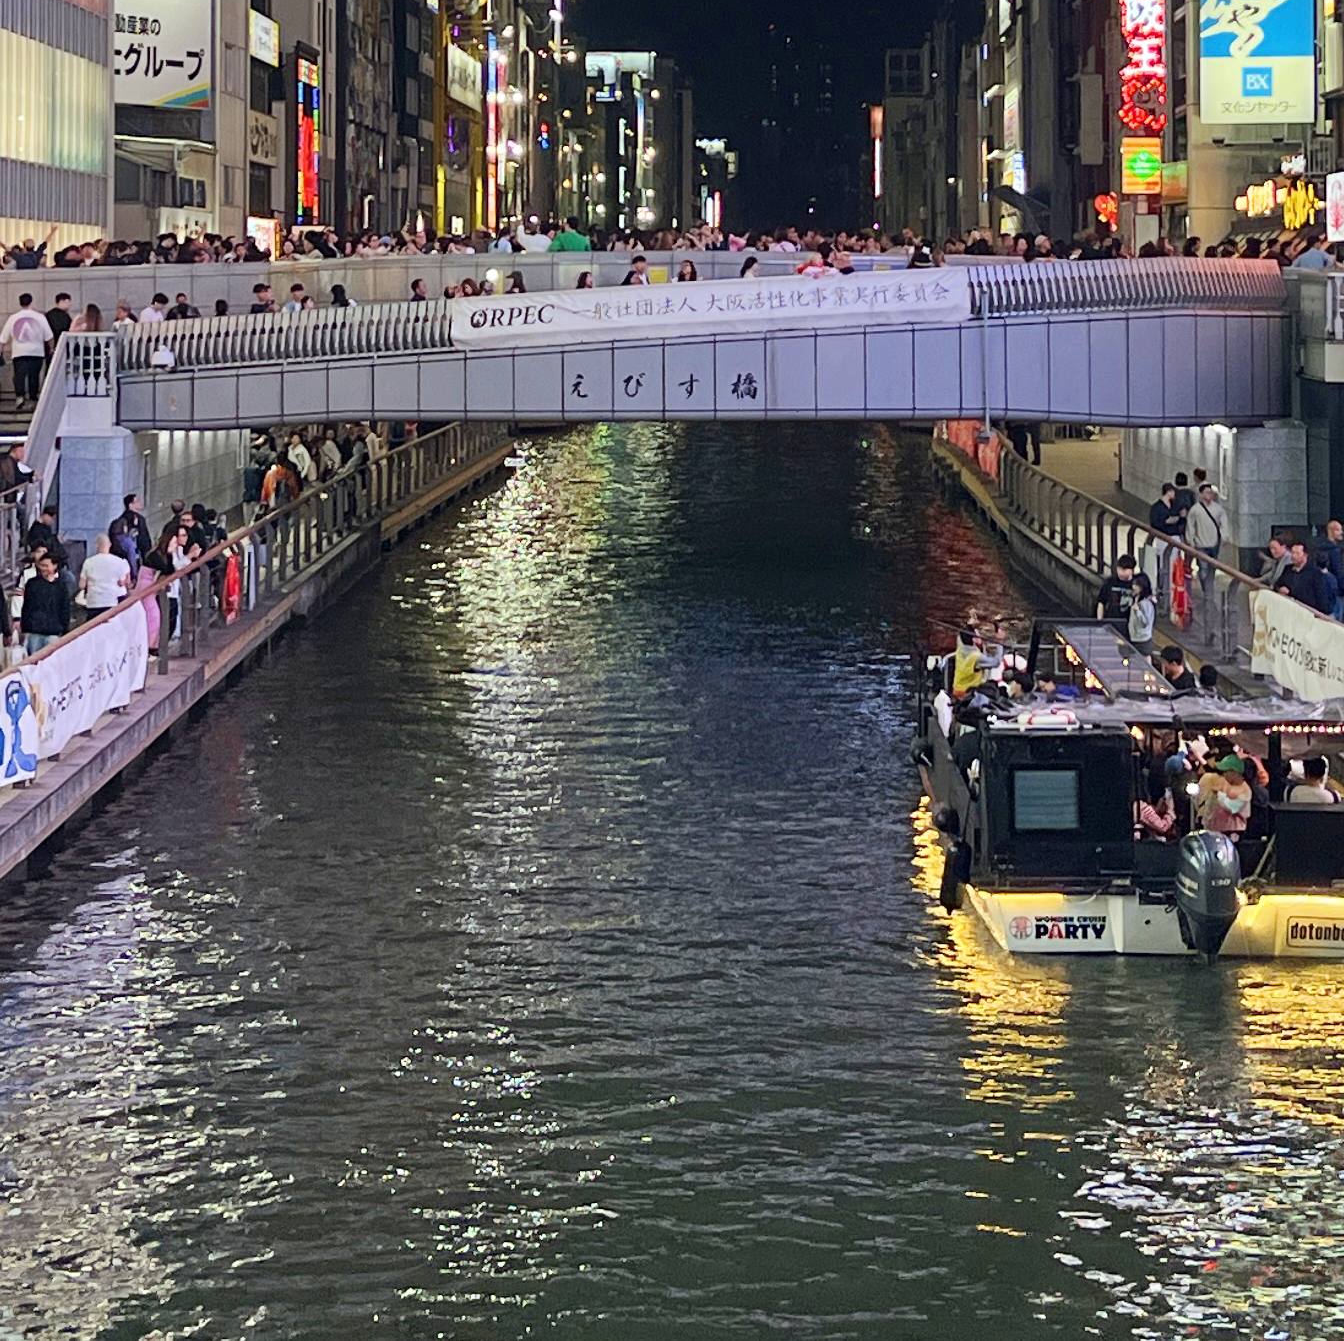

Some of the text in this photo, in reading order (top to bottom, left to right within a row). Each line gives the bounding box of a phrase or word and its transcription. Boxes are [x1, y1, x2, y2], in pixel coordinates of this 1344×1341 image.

[1246, 72, 1269, 90] BX
[571, 372, 759, 400] えびす橋
[1034, 923, 1107, 940] PARTY
